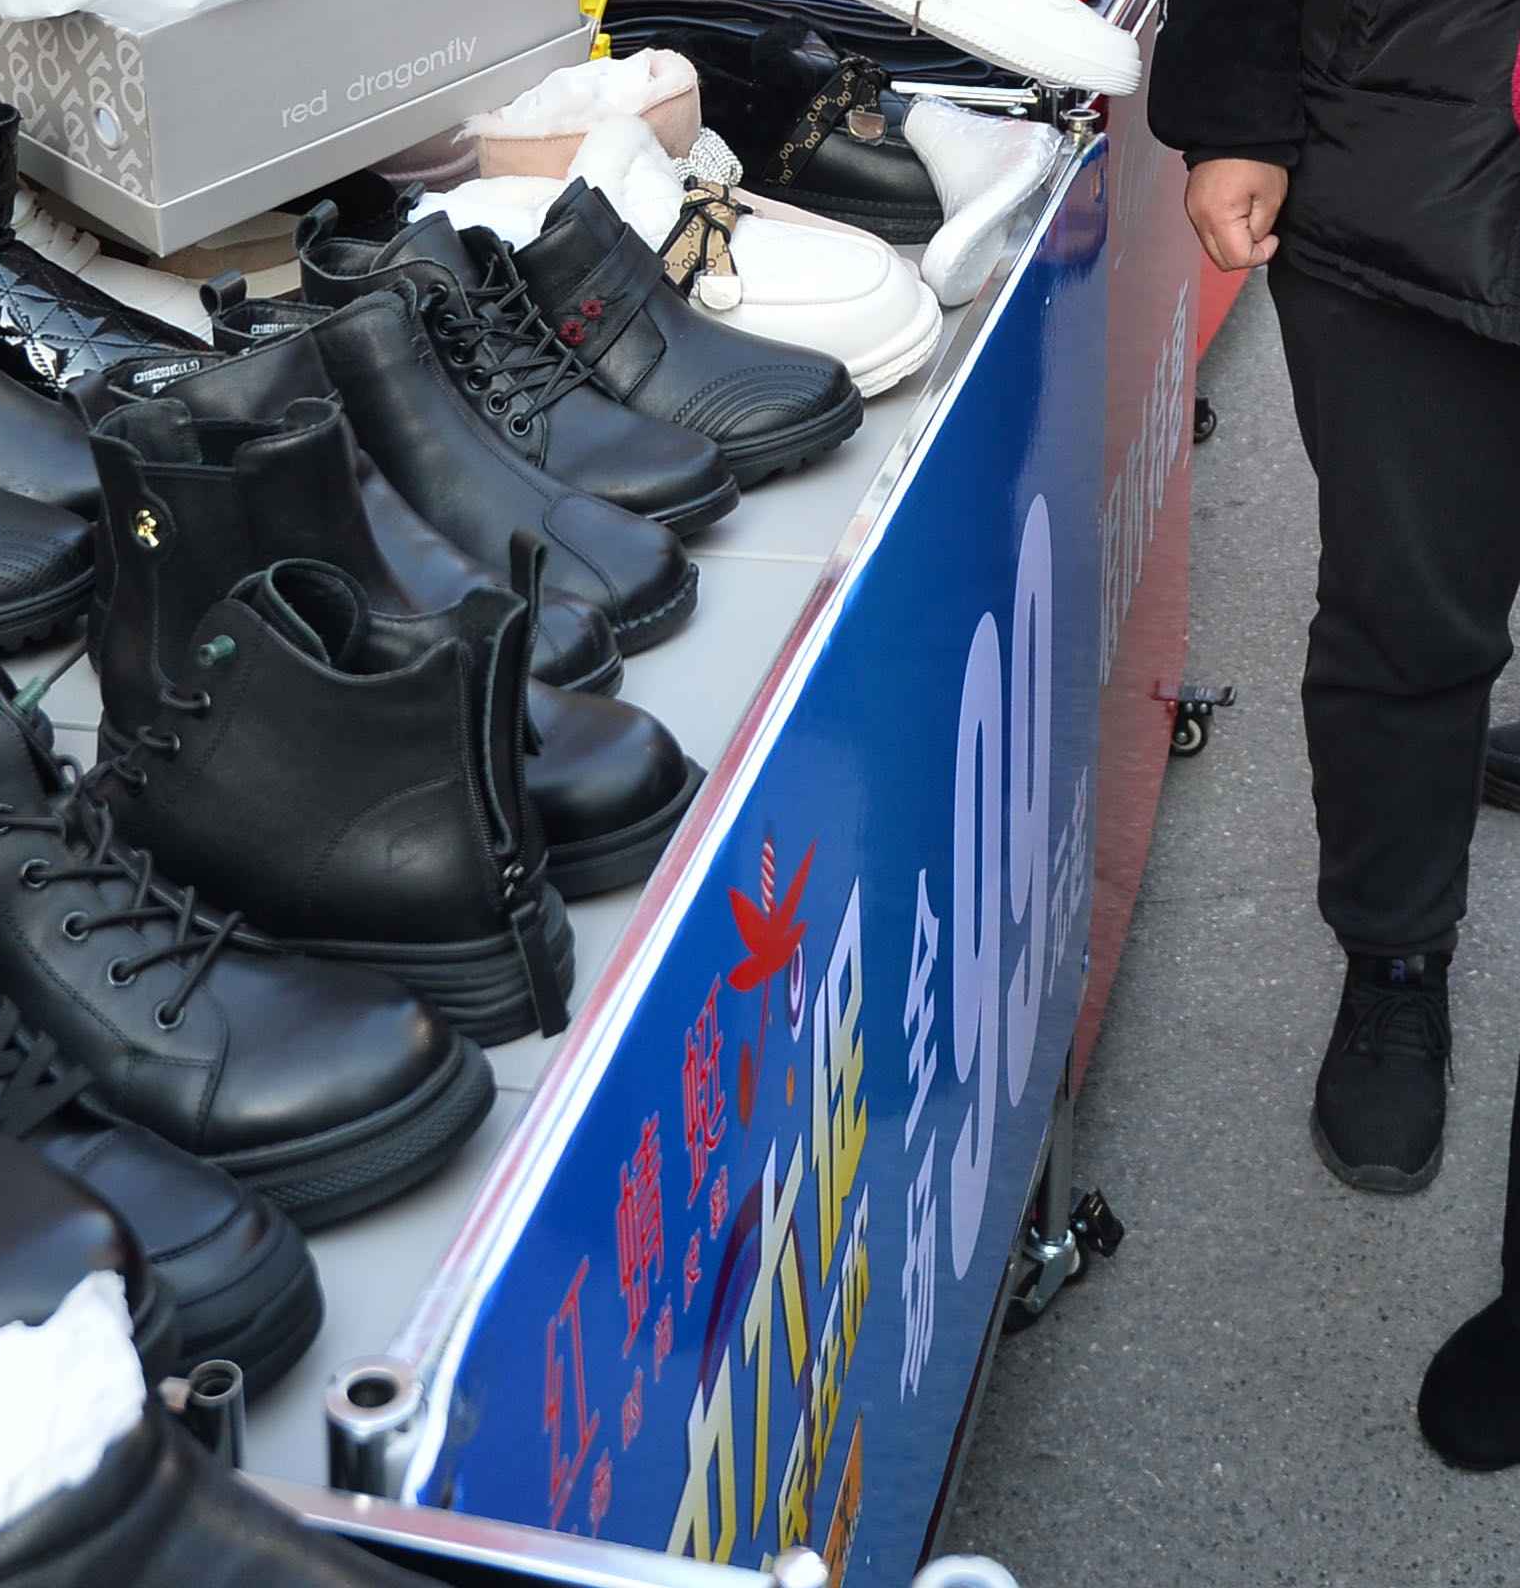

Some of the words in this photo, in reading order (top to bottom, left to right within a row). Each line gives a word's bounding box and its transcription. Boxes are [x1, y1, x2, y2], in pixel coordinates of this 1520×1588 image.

[280, 90, 328, 130] red
[346, 32, 480, 104] dragonfly
[901, 868, 940, 1404] 全场
[951, 493, 1054, 1282] 99
[543, 971, 726, 1532] 红蜻蜓
[761, 1181, 871, 1572] 民狂欢
